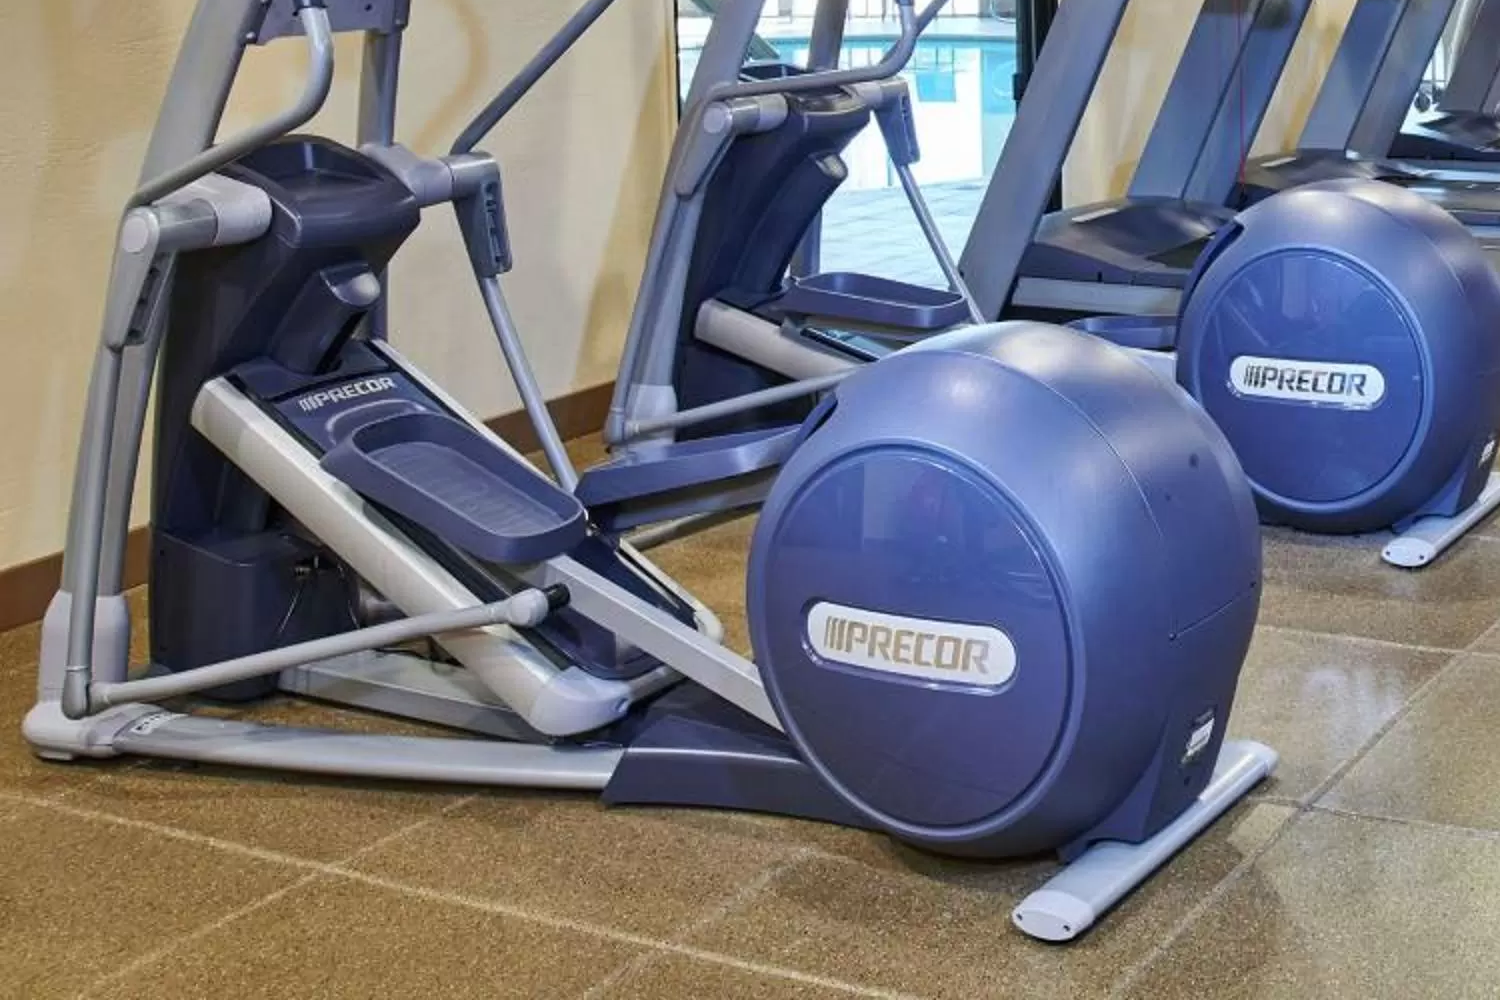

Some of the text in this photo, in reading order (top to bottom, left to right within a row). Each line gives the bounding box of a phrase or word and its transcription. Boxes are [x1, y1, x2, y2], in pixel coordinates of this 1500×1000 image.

[313, 377, 396, 407] PRECOR
[1261, 365, 1367, 396] PRECOR
[842, 621, 988, 674] PRECOR
